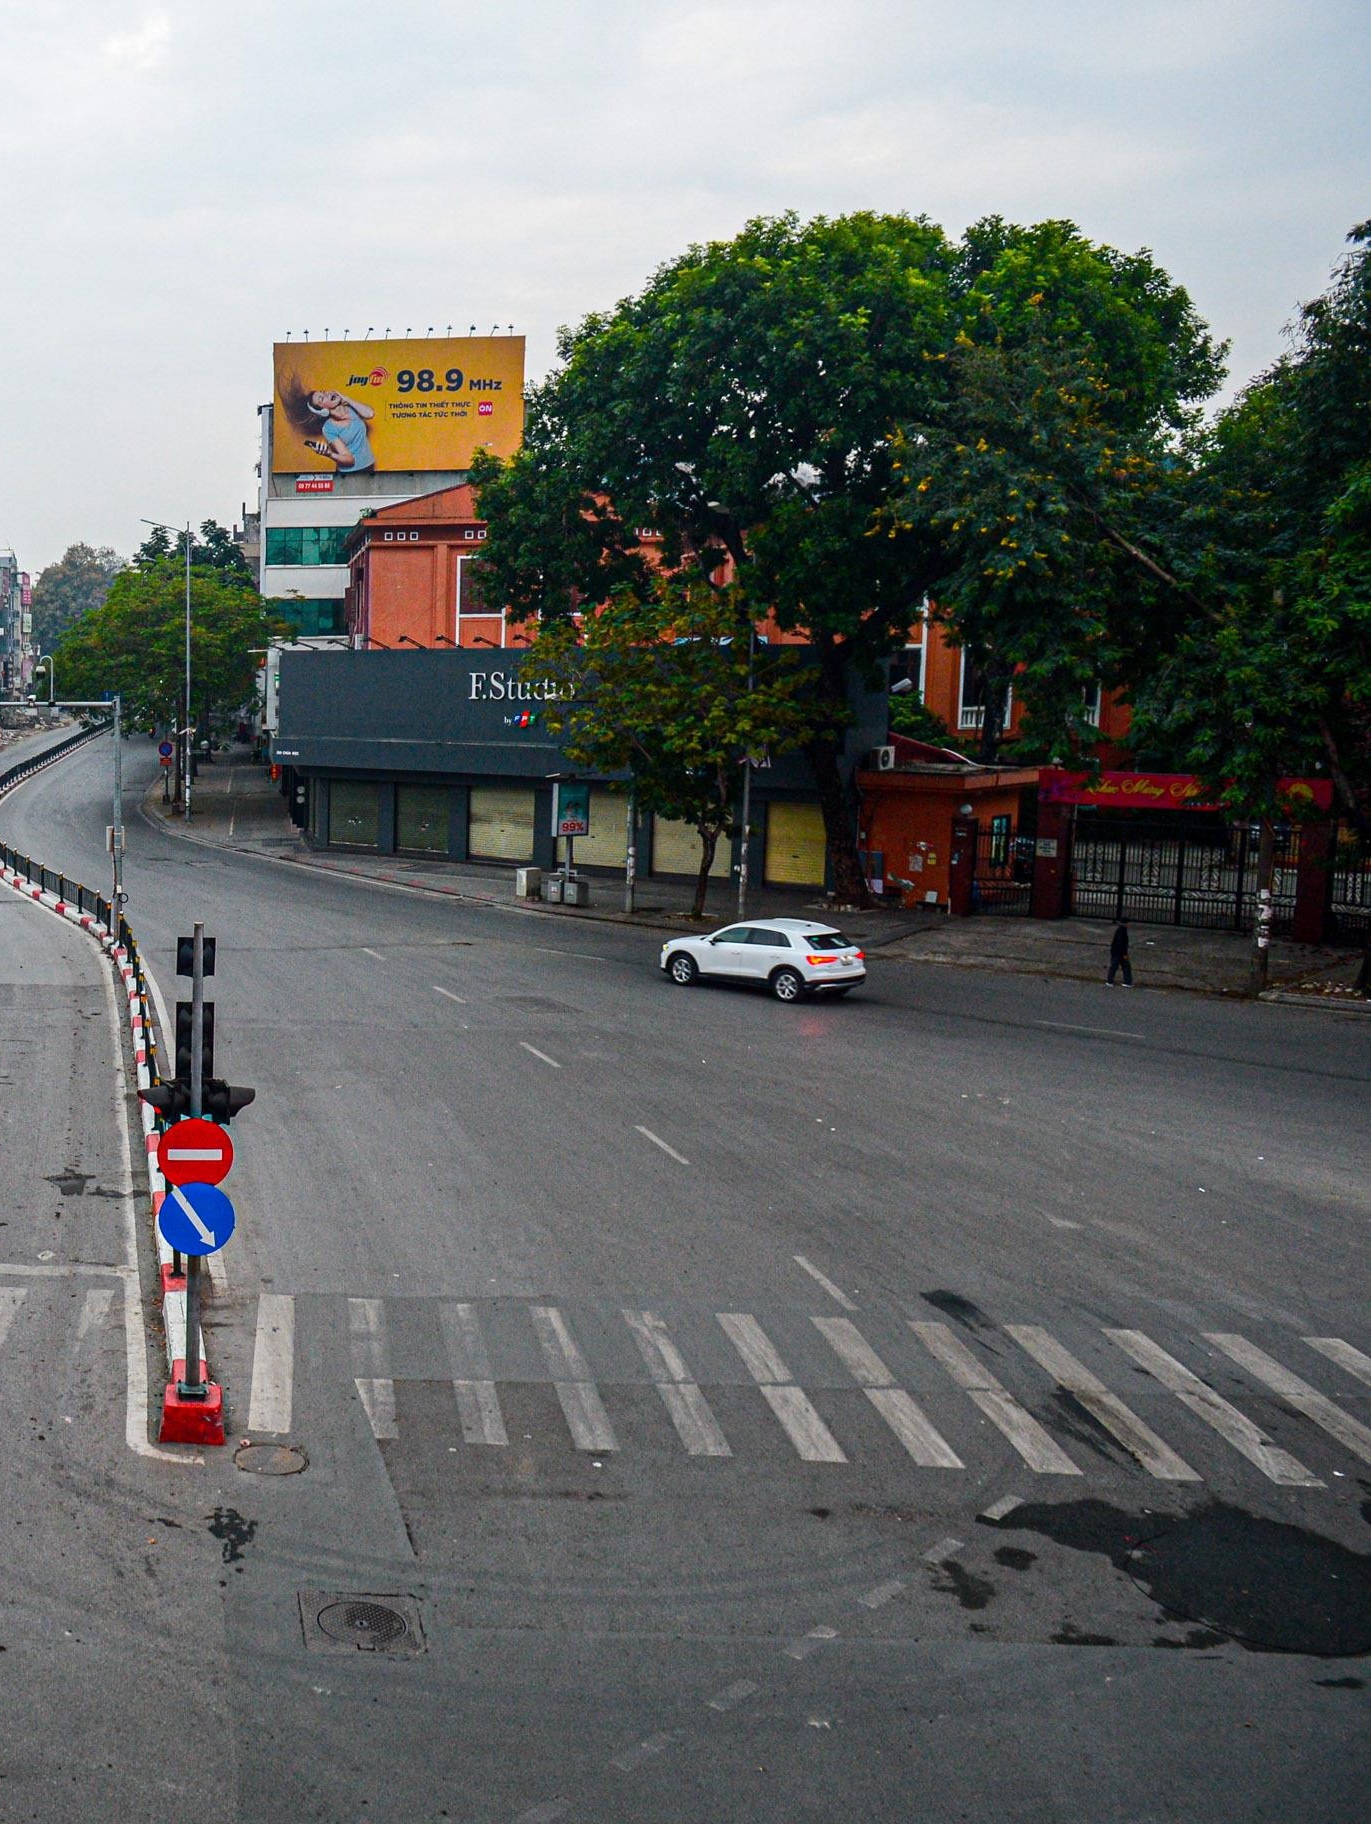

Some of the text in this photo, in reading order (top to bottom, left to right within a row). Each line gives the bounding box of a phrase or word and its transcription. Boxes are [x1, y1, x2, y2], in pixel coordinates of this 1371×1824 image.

[397, 368, 464, 393] 98.9
[469, 379, 502, 391] MHz
[478, 404, 493, 412] ON
[504, 716, 512, 726] by
[562, 822, 584, 832] 99%
